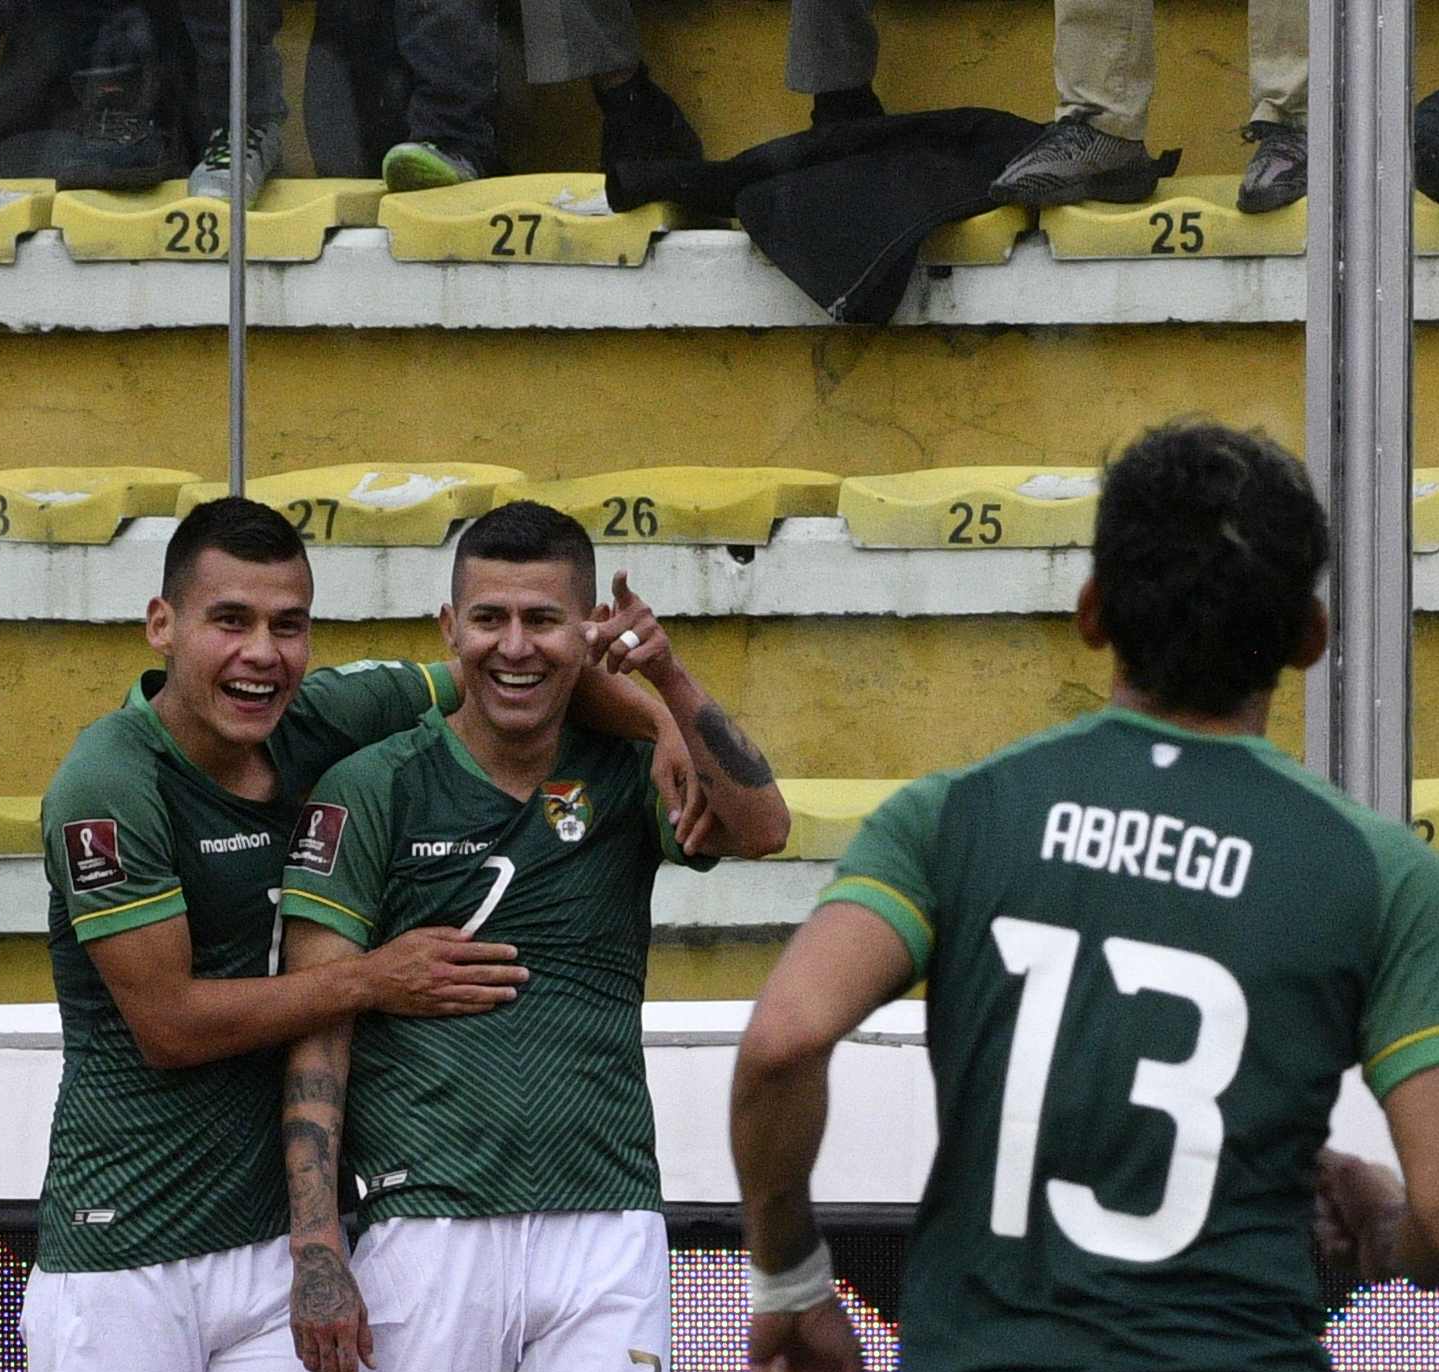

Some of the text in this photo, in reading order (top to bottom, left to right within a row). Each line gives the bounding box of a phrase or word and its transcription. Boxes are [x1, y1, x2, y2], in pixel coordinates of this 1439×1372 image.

[164, 210, 221, 254] 28
[489, 212, 543, 257] 27
[1148, 211, 1205, 255] 25
[295, 496, 340, 541] 27
[601, 495, 659, 538] 26
[947, 502, 1003, 545] 25
[199, 831, 271, 854] marathon
[1039, 801, 1254, 901] ABREGO
[460, 855, 516, 937] 7
[990, 915, 1250, 1264] 13
